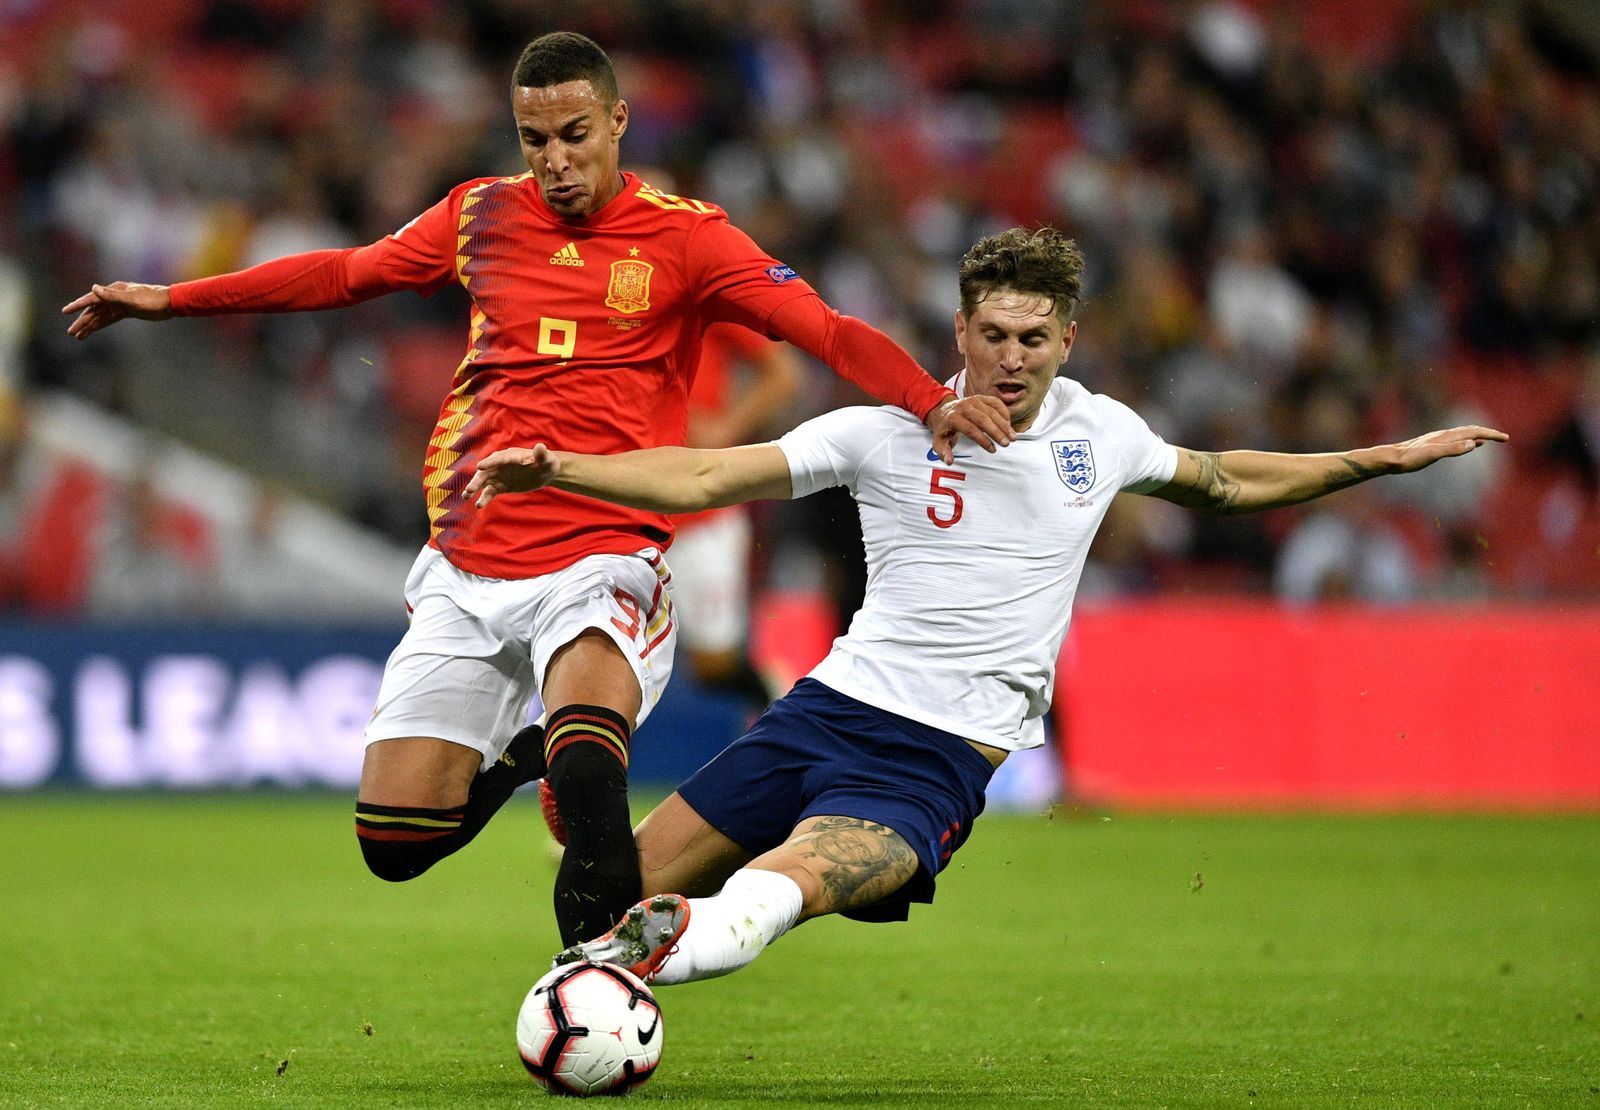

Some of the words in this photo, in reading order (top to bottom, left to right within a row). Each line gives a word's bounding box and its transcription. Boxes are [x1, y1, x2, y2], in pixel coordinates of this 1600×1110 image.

[549, 257, 585, 267] adidas
[536, 316, 577, 366] 9
[926, 467, 967, 529] 5
